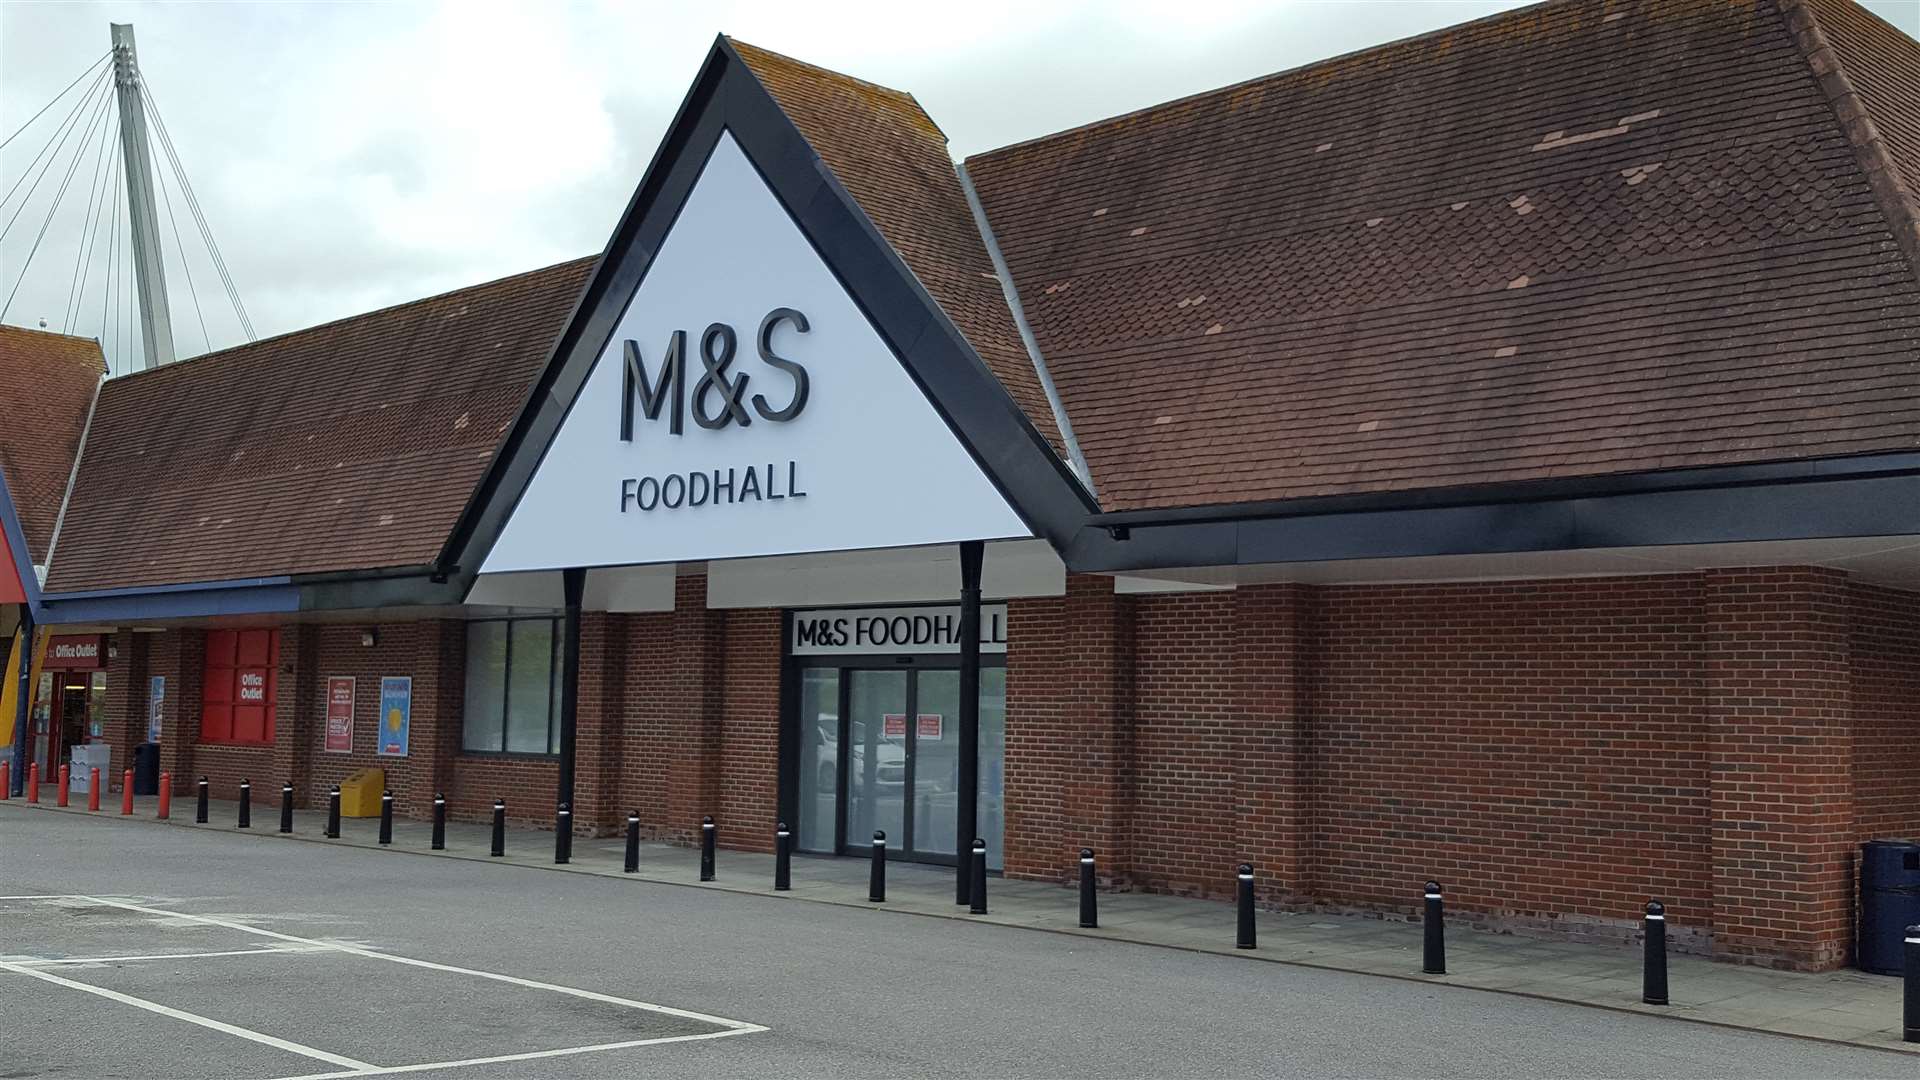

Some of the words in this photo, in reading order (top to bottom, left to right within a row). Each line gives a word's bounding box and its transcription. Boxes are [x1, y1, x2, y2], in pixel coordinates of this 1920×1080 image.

[620, 307, 810, 441] M&S
[620, 461, 807, 513] FOODHALL
[797, 619, 849, 647] M&S
[856, 614, 1008, 646] FOODHL
[56, 644, 75, 658] Office
[76, 643, 97, 657] Outlet
[242, 673, 262, 685] Office
[241, 687, 262, 699] Outlet
